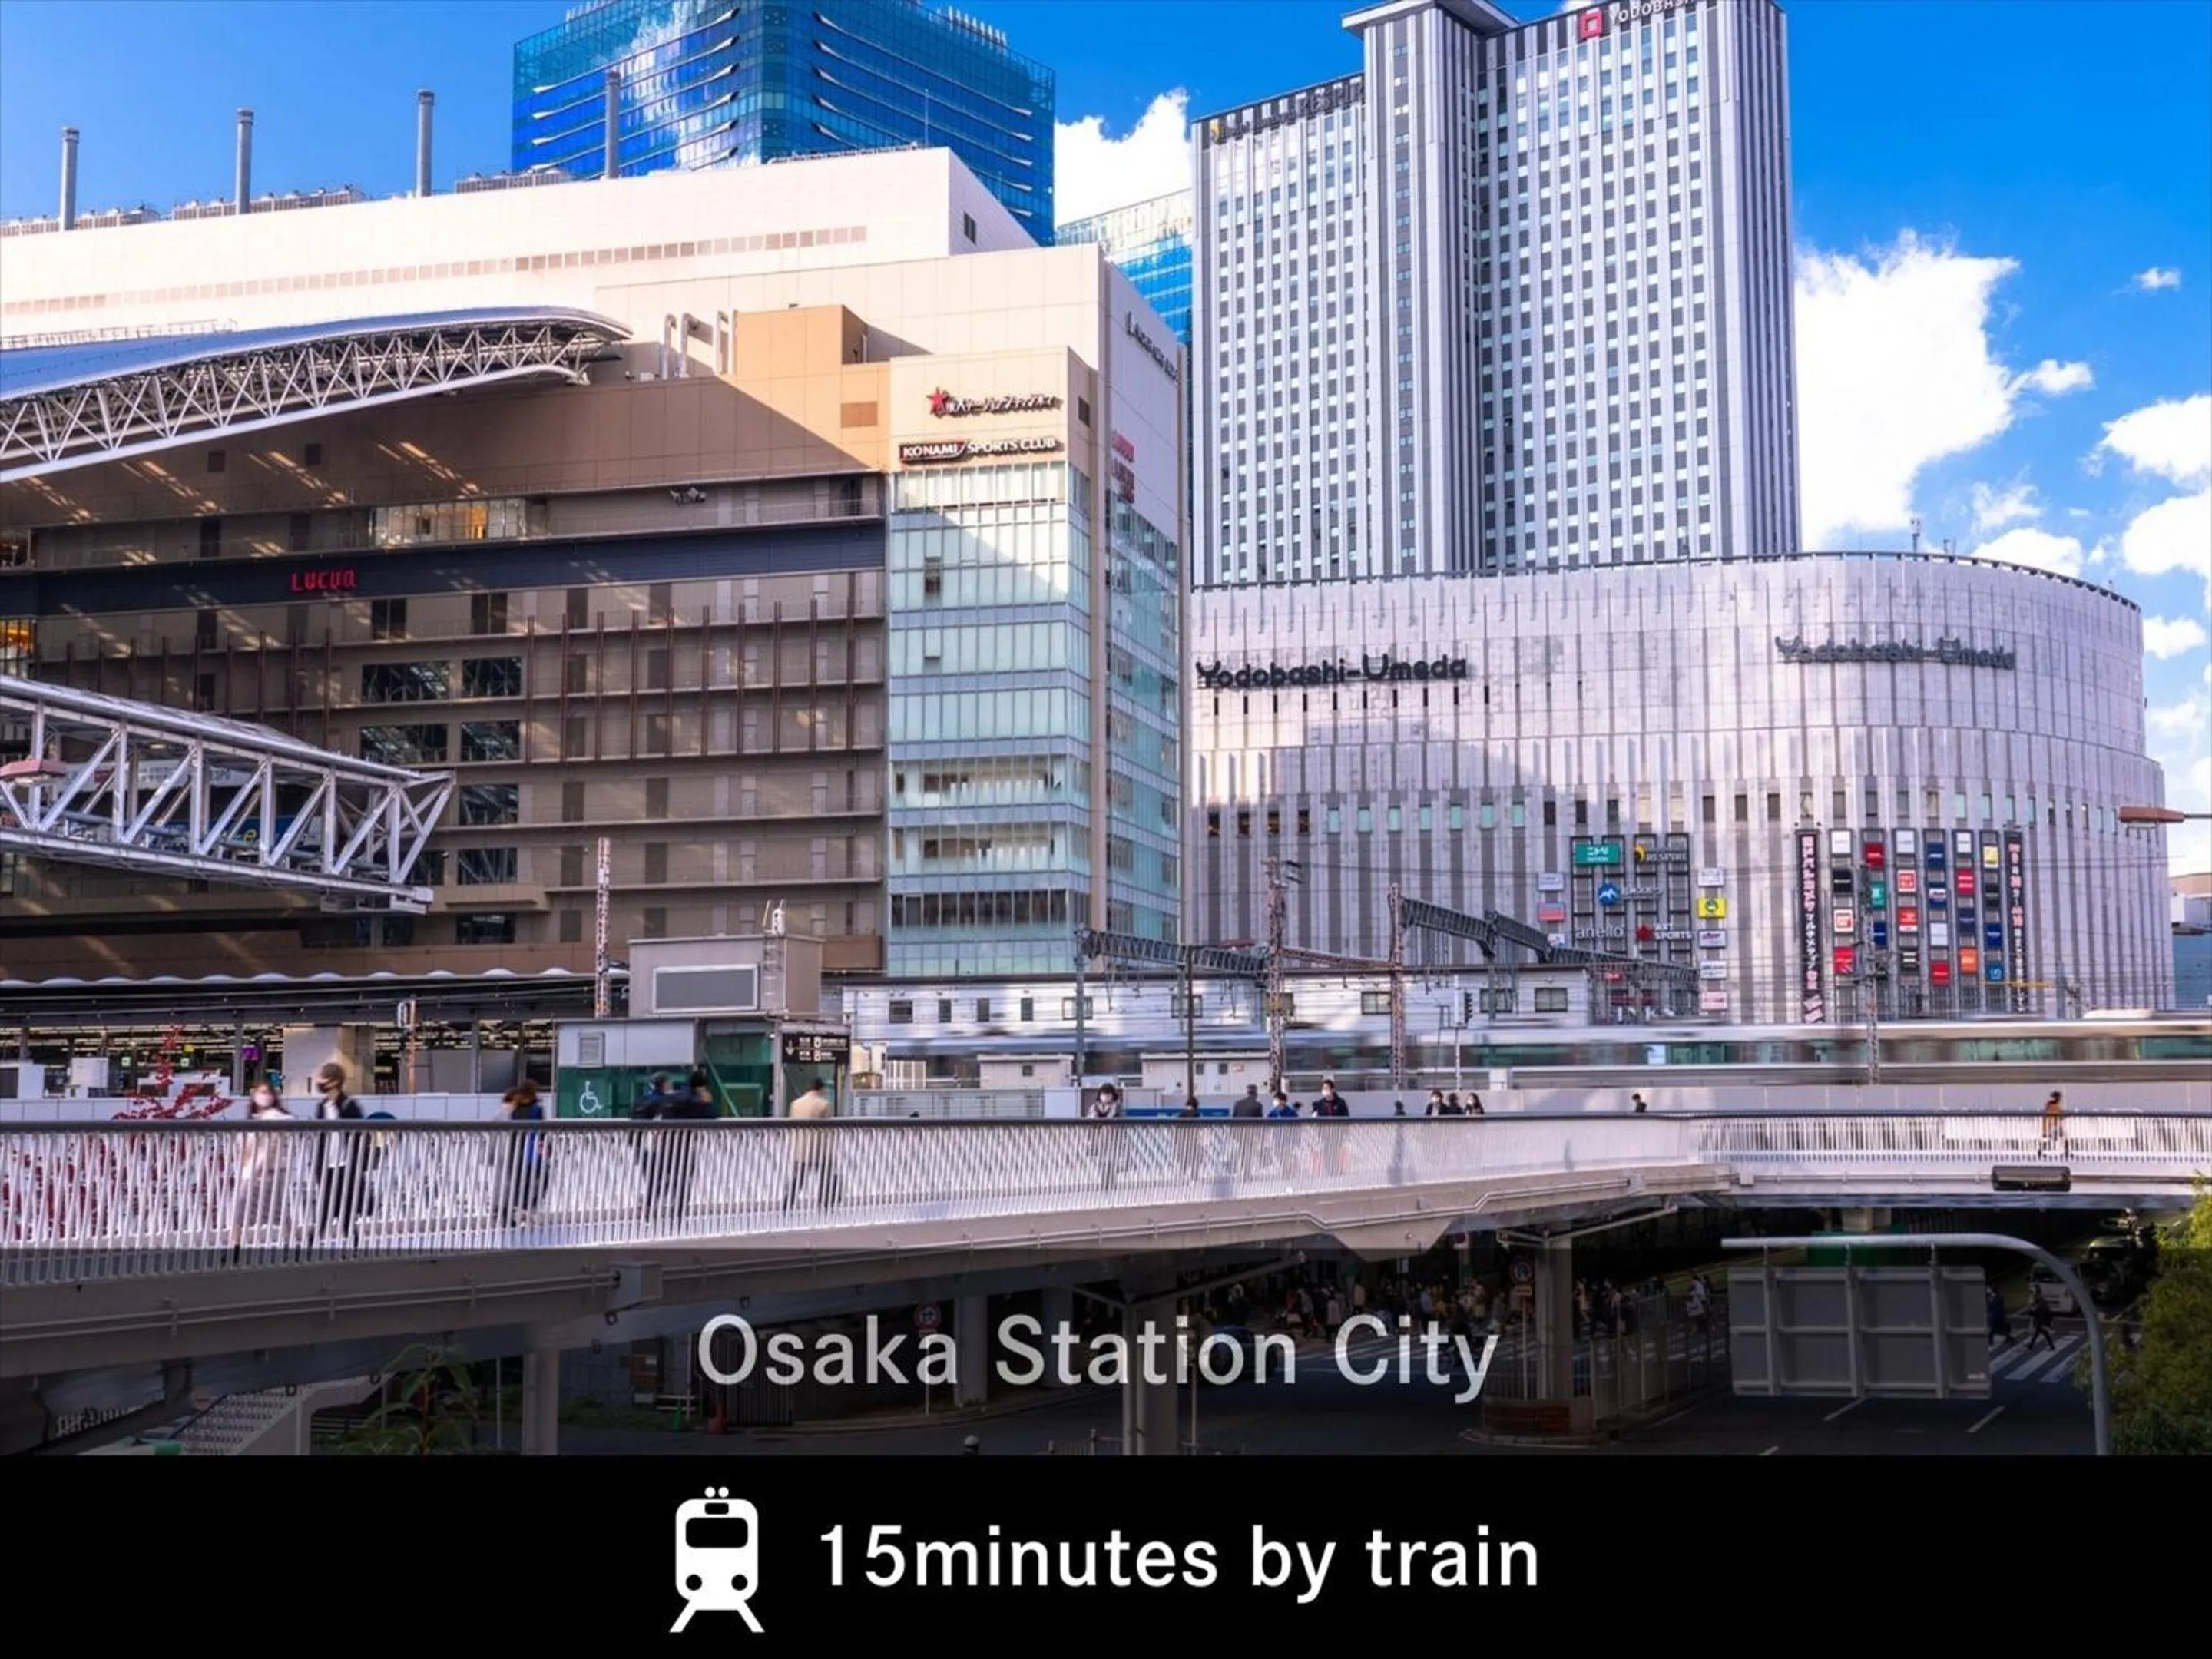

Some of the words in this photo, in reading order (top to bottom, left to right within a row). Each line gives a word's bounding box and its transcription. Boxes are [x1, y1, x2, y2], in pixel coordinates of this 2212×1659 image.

[902, 443, 959, 459] KONAMI
[968, 440, 1018, 454] SPORTS
[1019, 436, 1056, 451] CLUB
[1196, 654, 1468, 688] Yodobashi-Umeda
